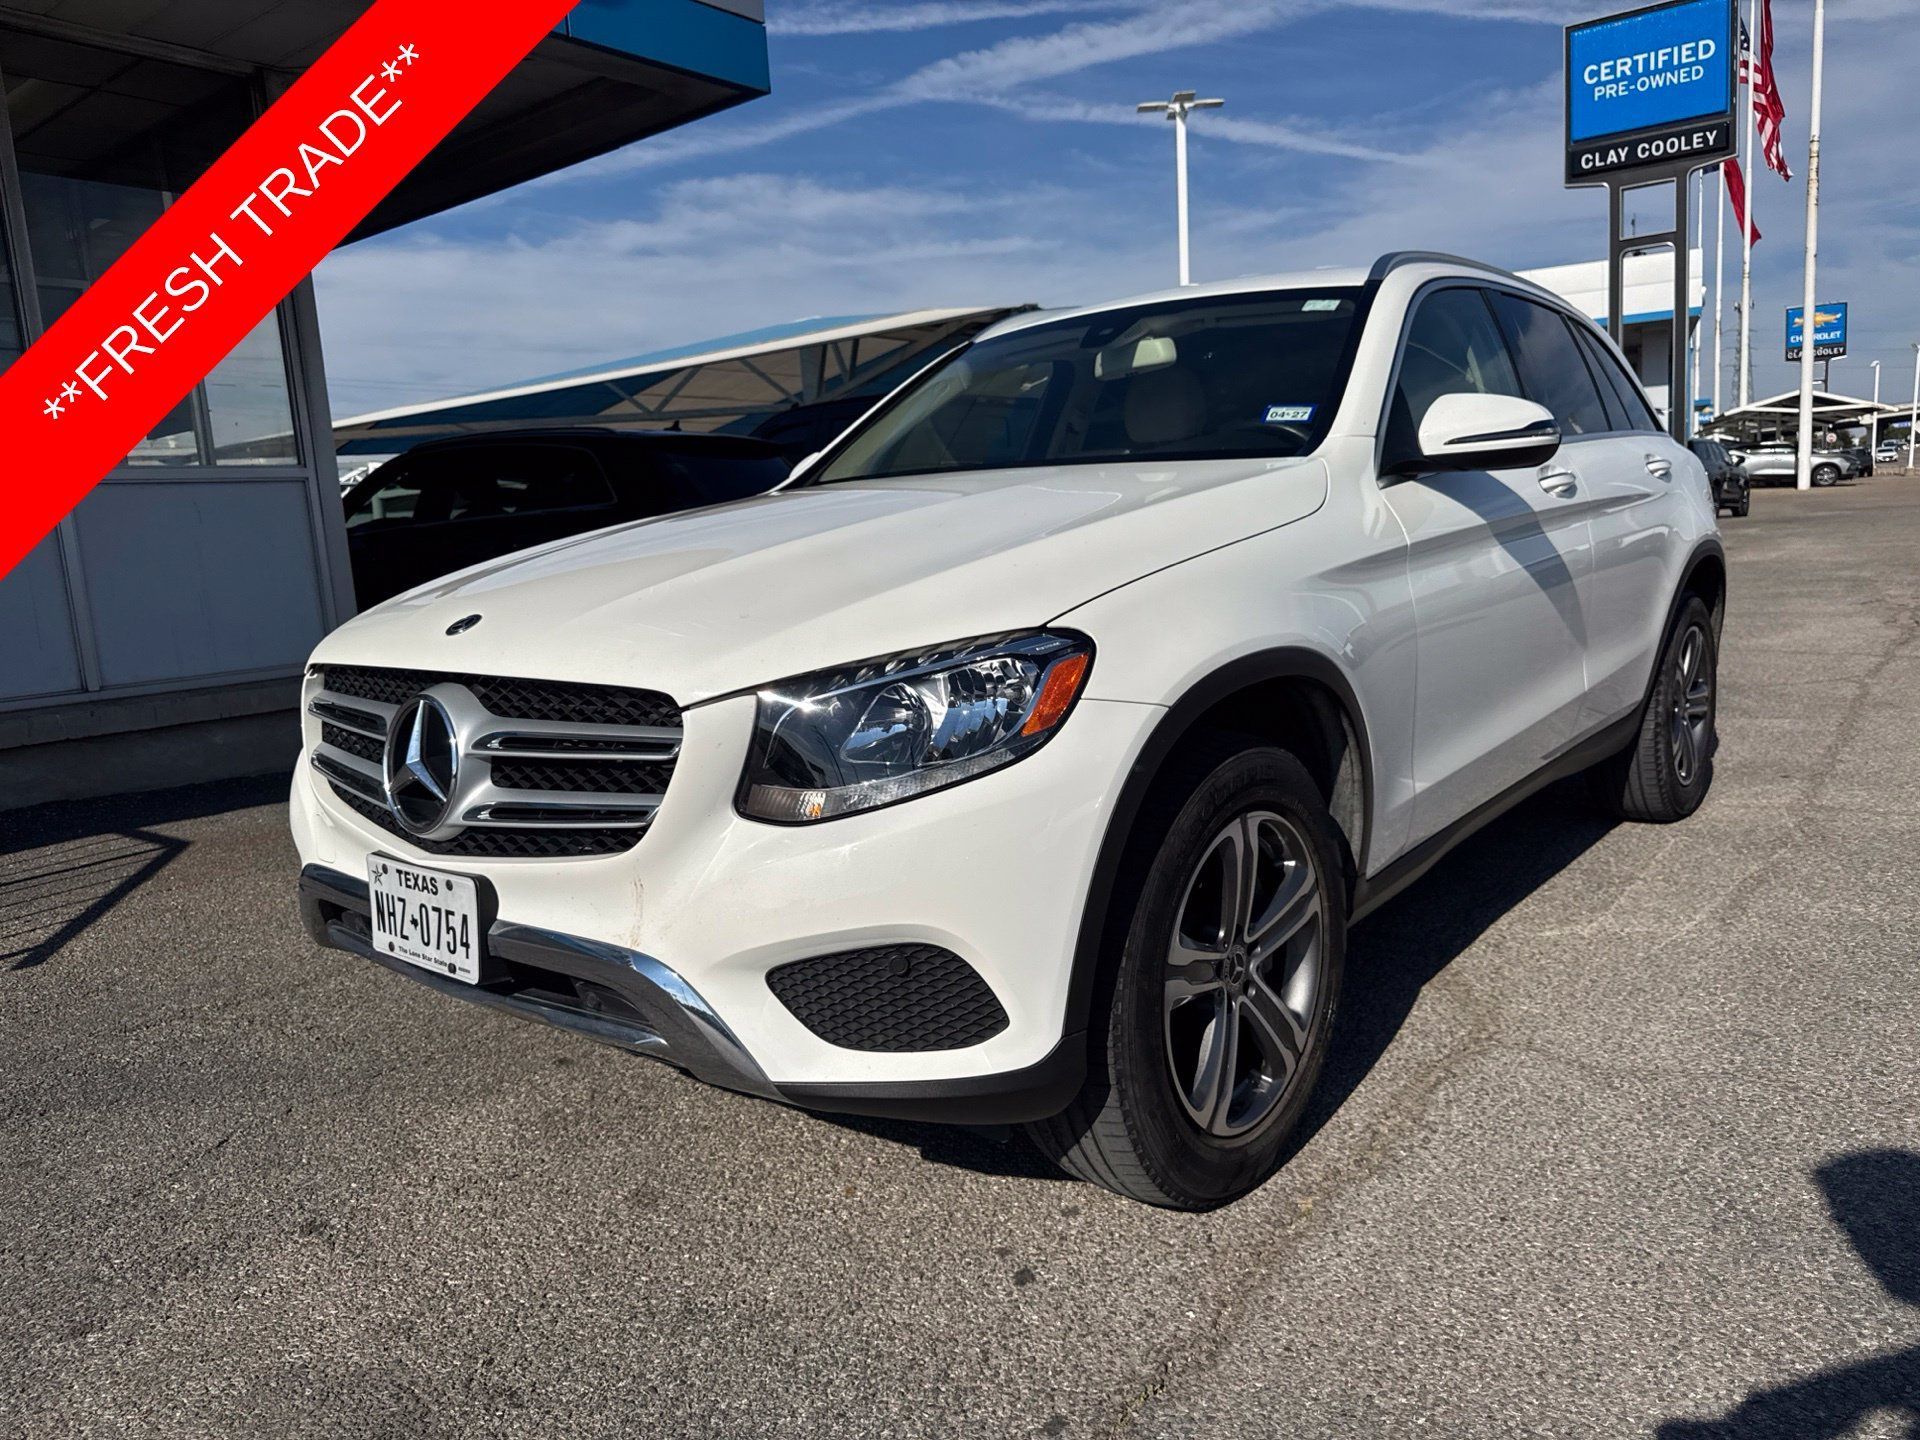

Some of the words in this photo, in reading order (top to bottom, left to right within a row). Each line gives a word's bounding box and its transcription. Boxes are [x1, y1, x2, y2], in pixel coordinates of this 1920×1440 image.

[1584, 39, 1716, 85] CERTIFIED
[1594, 66, 1704, 101] PRE-OWNED
[1581, 147, 1629, 169] CLAY
[1637, 130, 1717, 159] COOLEY
[1790, 331, 1841, 343] CHROLET
[1787, 350, 1803, 359] CLA
[395, 868, 439, 896] TEXAS
[399, 946, 408, 954] The
[409, 949, 421, 959] Lone
[422, 953, 433, 963] Star
